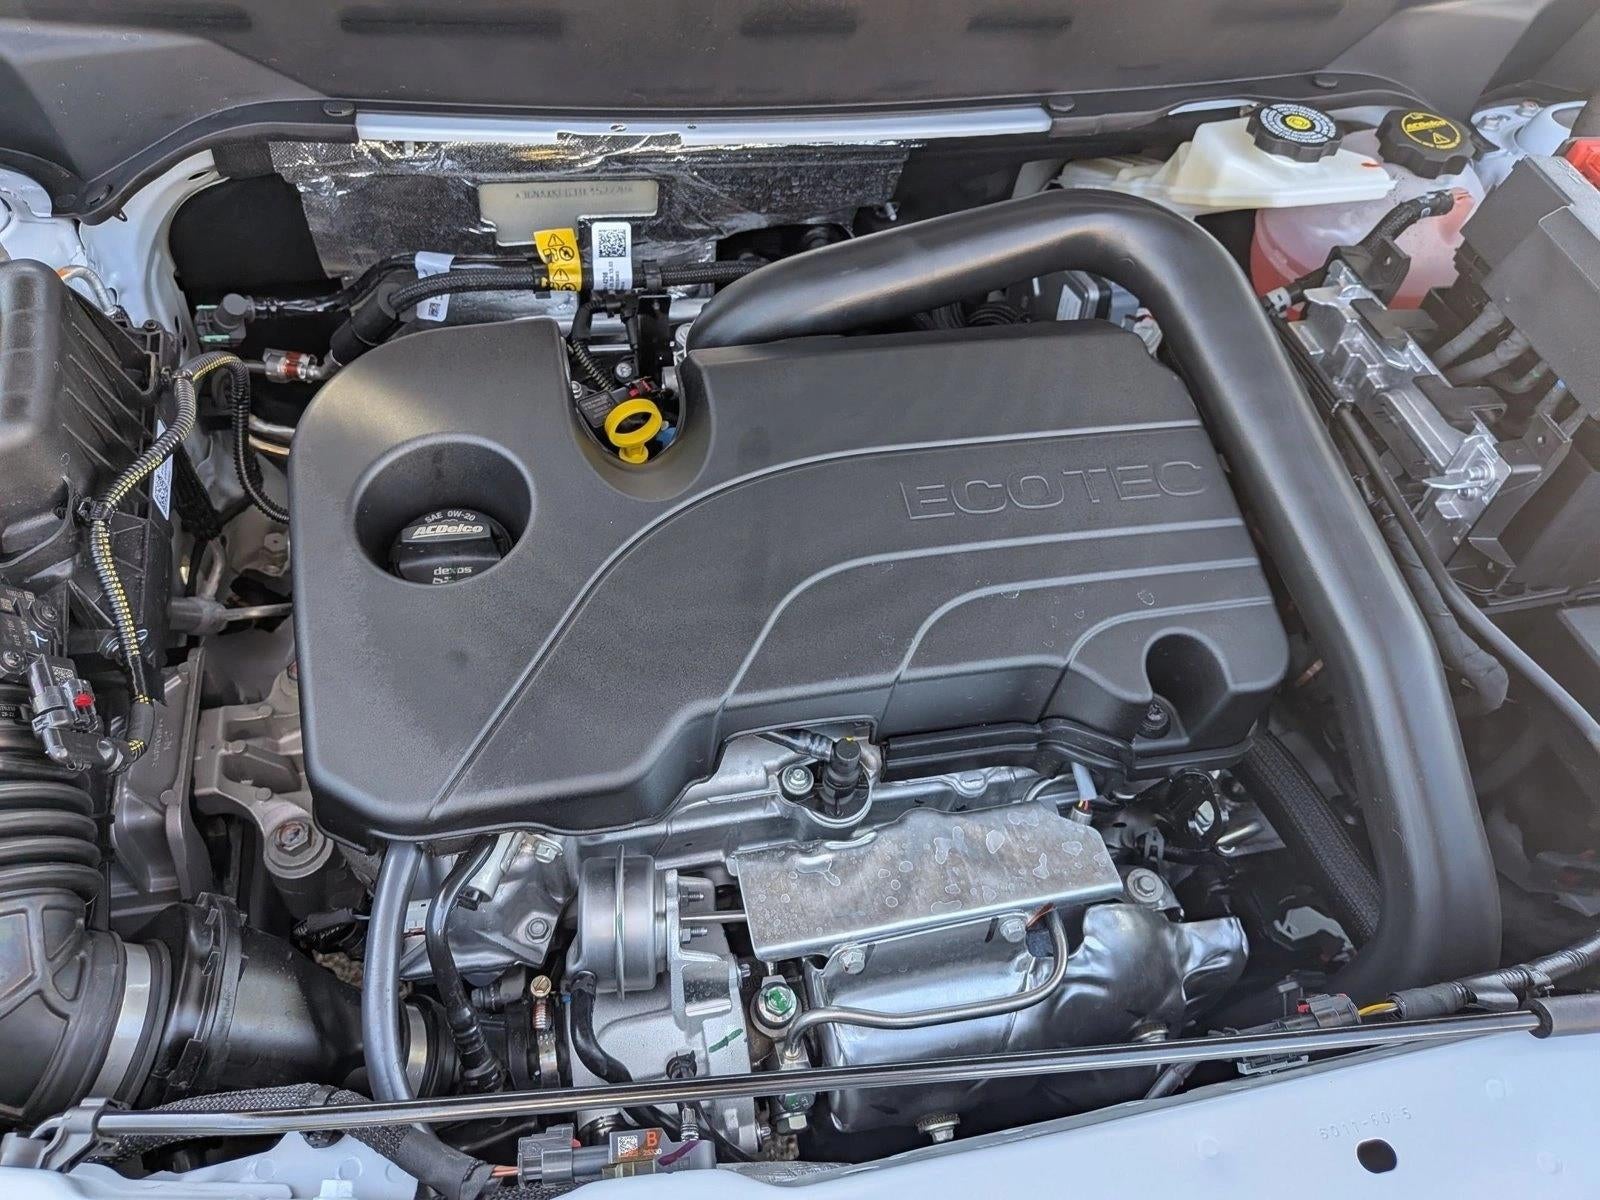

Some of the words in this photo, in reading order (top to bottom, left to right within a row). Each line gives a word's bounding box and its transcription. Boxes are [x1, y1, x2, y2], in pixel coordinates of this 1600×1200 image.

[899, 461, 1207, 520] ECOTEC
[424, 511, 443, 523] SAE
[447, 510, 476, 521] 0W-20
[412, 523, 484, 539] ACDelco
[433, 565, 473, 576] dexos
[646, 1131, 658, 1147] B
